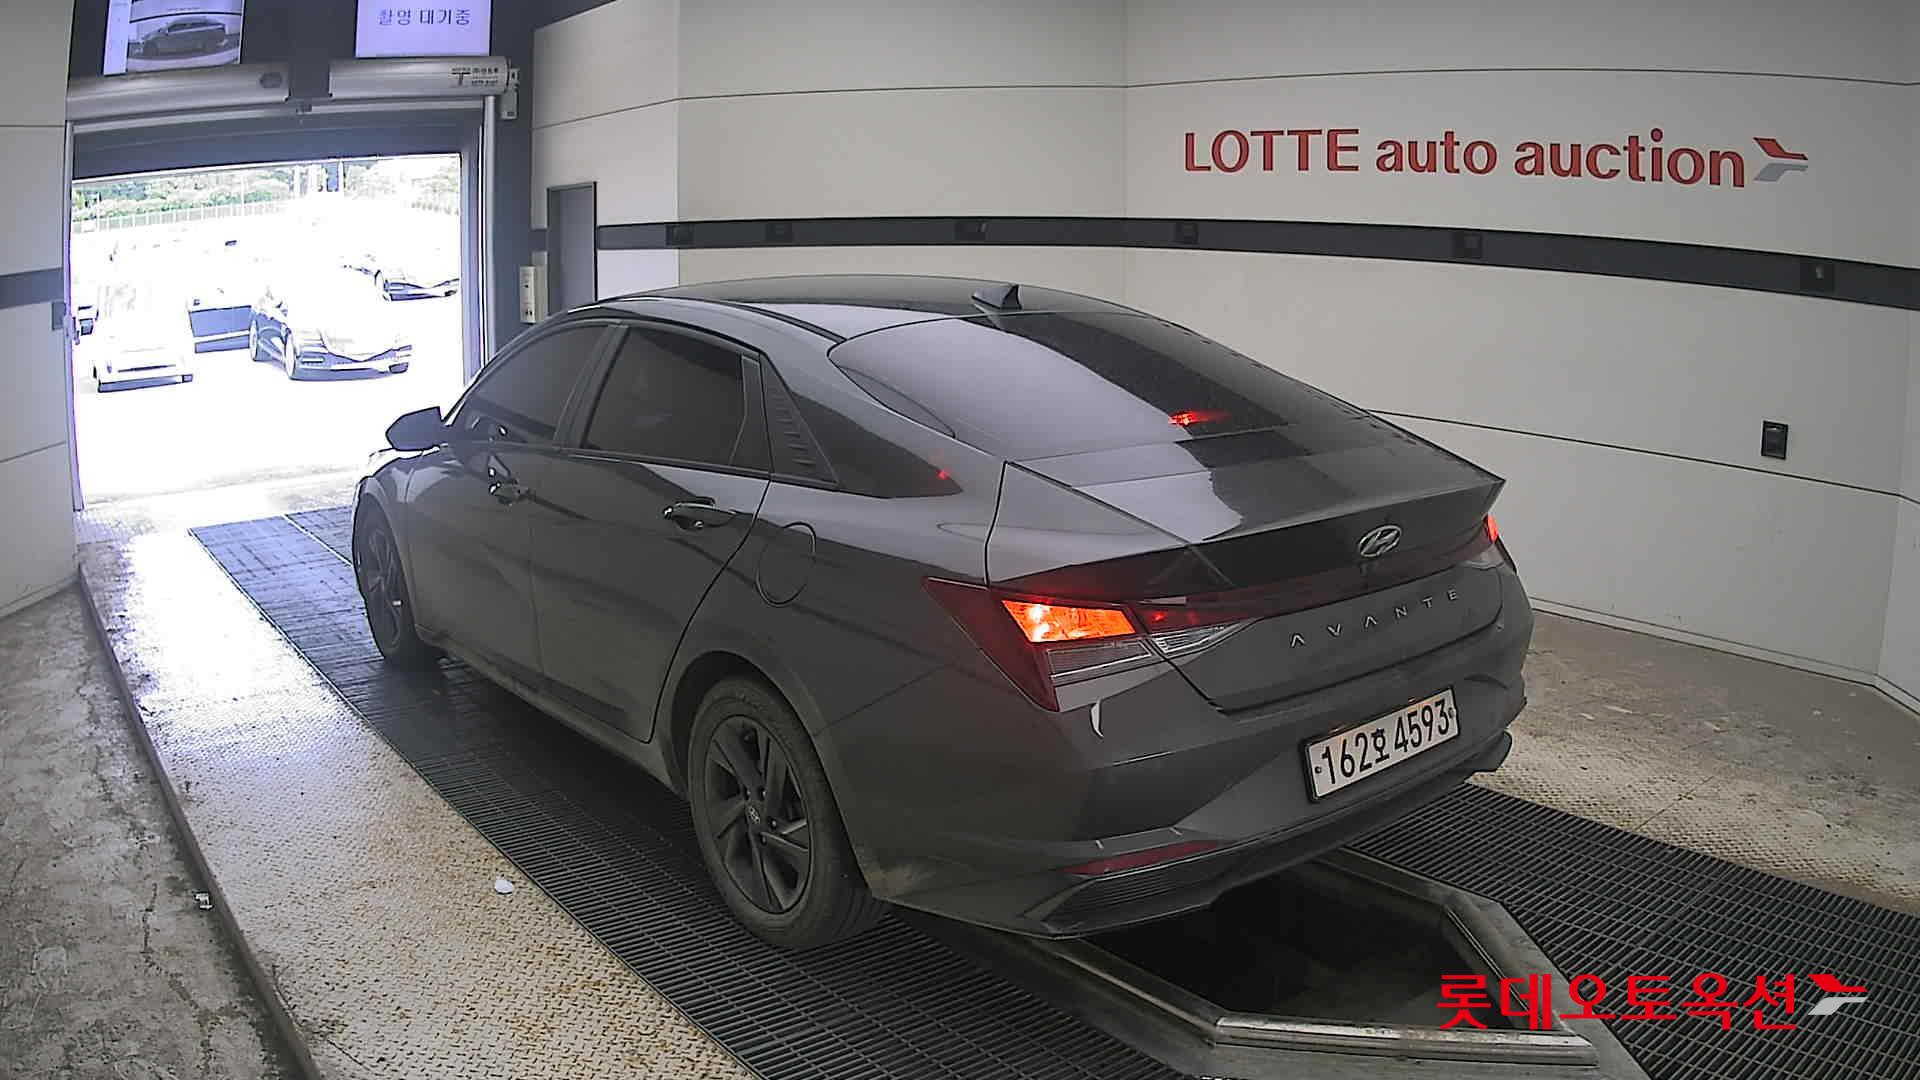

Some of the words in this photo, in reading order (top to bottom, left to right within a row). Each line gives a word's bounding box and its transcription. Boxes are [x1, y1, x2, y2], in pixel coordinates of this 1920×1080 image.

[419, 8, 471, 26] 대기중
[1185, 128, 1360, 173] LOTTE
[1376, 130, 1498, 175] auto
[1514, 128, 1745, 188] auction
[1291, 589, 1458, 647] AVANTE
[1321, 728, 1389, 785] 162호
[1394, 698, 1449, 753] 4593
